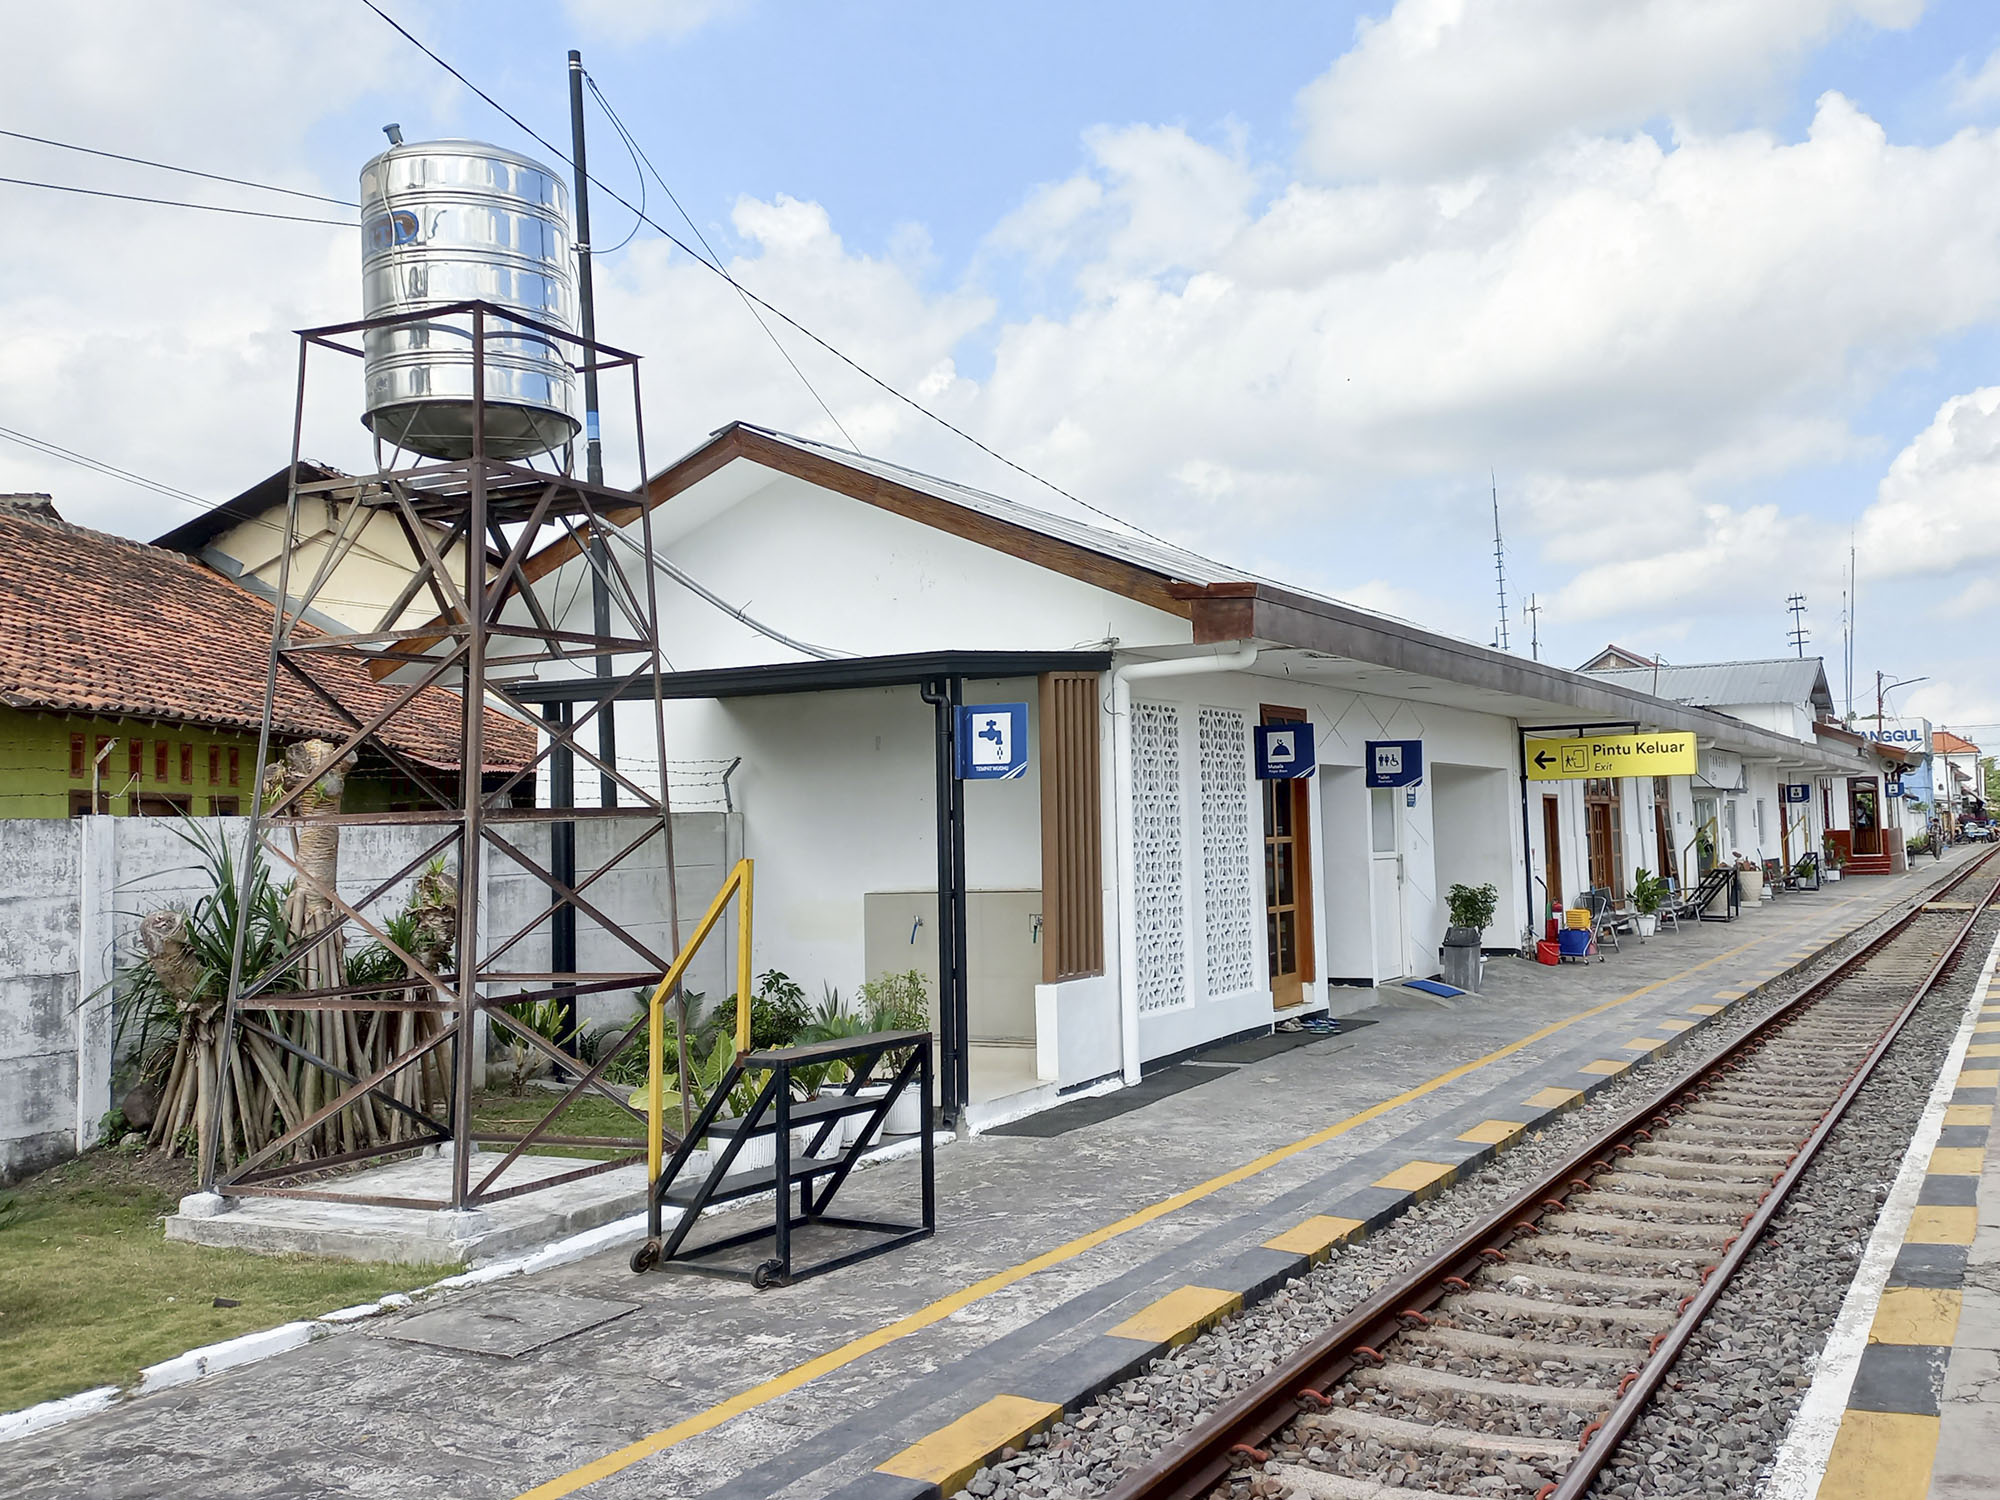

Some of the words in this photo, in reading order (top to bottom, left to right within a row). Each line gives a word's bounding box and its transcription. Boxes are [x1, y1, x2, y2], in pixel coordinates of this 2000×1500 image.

[1593, 744, 1631, 756] Pintu
[1635, 741, 1685, 755] Keluar
[1594, 761, 1613, 772] Exit
